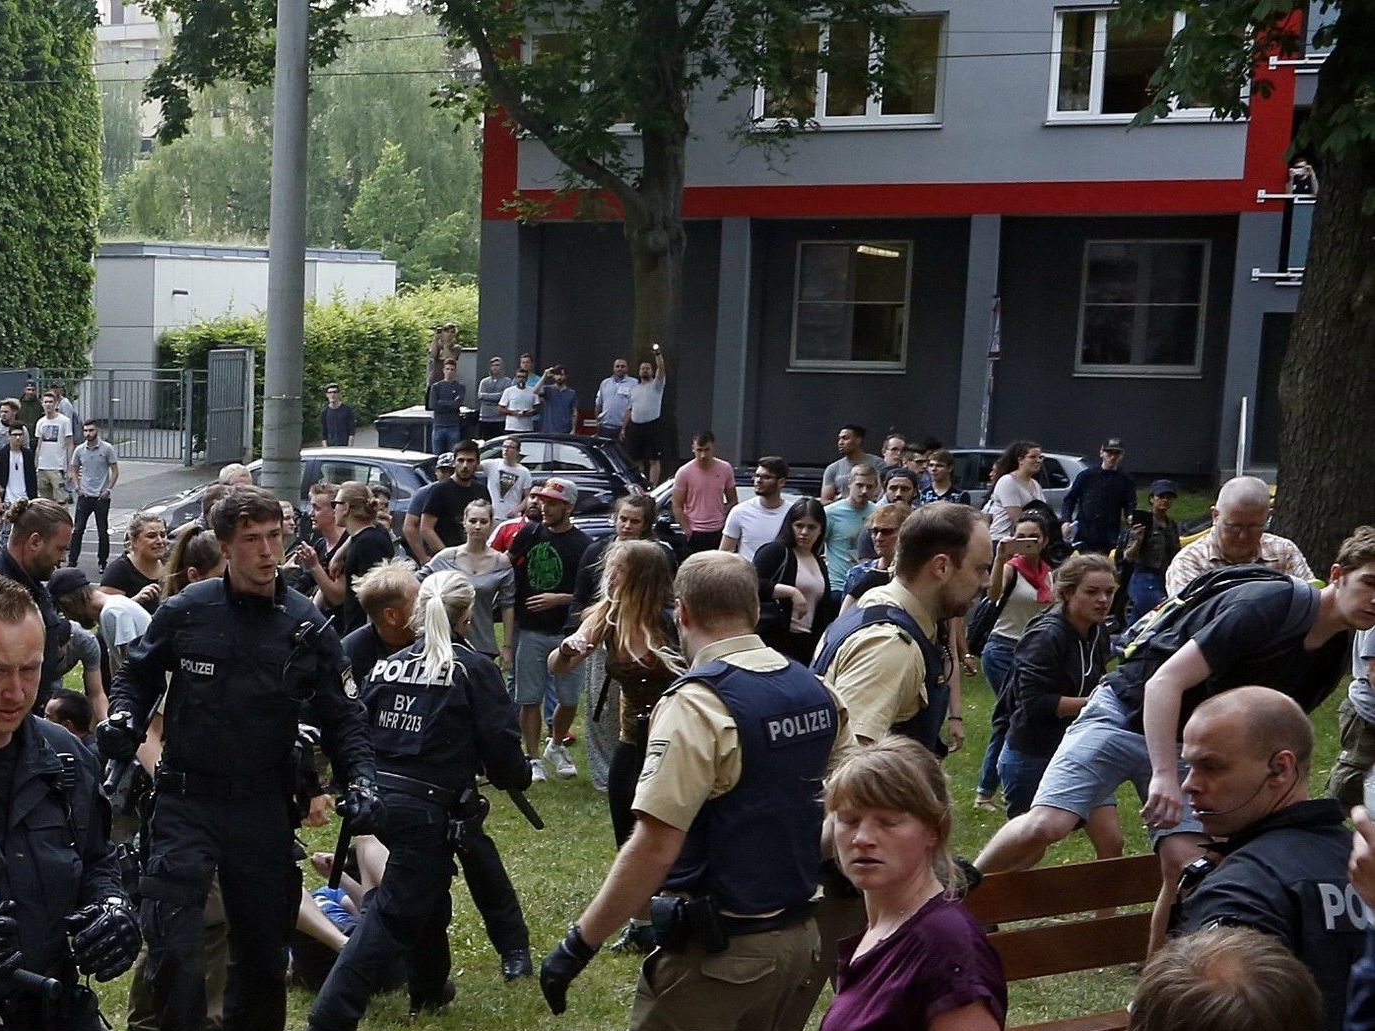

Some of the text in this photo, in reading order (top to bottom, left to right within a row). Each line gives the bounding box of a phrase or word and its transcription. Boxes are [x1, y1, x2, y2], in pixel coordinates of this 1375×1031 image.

[180, 658, 215, 676] POLIZEI
[369, 659, 455, 687] POLIZEI
[393, 694, 418, 712] BY
[378, 710, 423, 733] MFR 7213
[768, 708, 832, 741] POLIZEI
